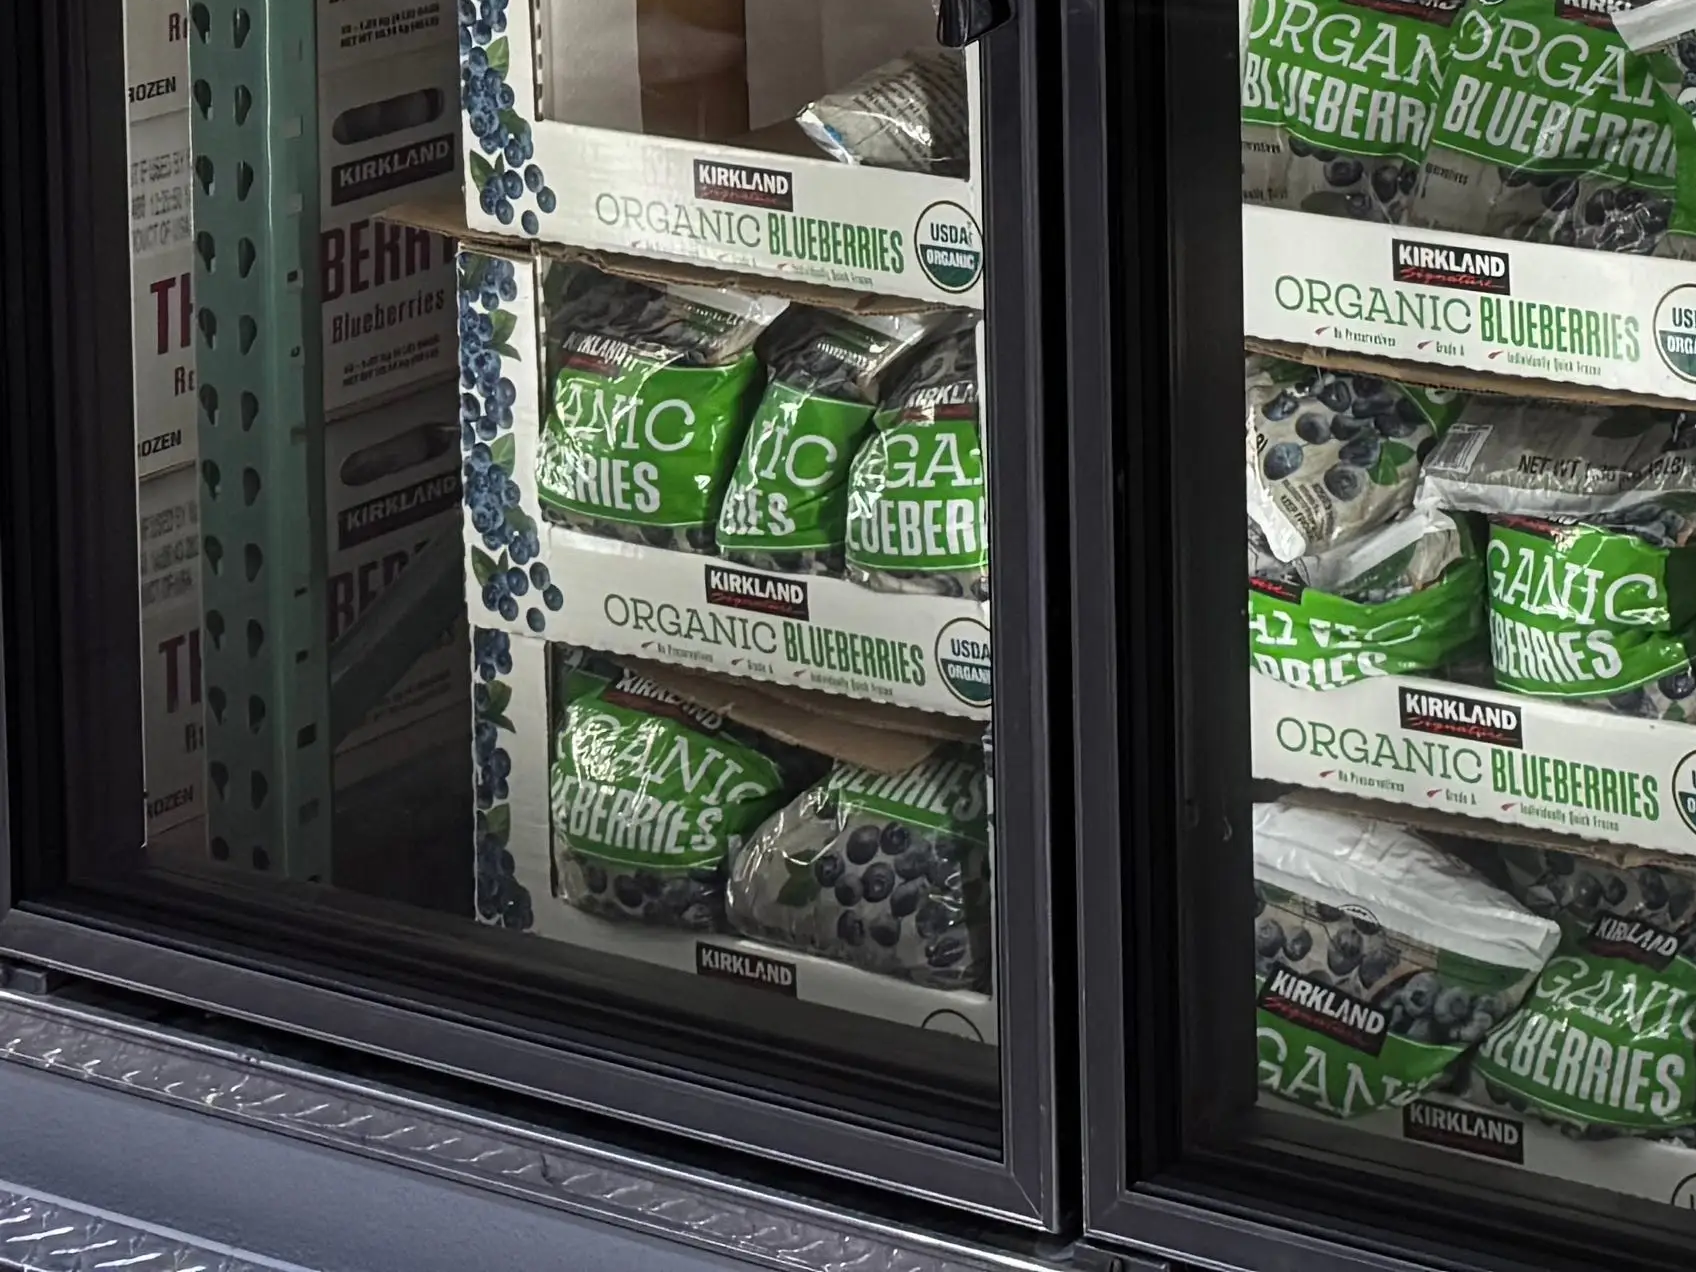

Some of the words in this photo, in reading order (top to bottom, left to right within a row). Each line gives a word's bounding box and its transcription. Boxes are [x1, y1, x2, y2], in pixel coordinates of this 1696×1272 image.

[339, 140, 450, 187] KIRKLAND
[699, 165, 789, 195] KIRKLAND
[595, 193, 762, 248] ORGANIC
[768, 213, 905, 274] BLUEBERRIES
[1400, 245, 1506, 277] KIRKLAND
[332, 287, 445, 345] Blueberries
[1275, 276, 1471, 334] ORGANIC
[1480, 297, 1641, 362] BLUEBERRIES
[710, 572, 804, 604] KIRKLAND
[603, 594, 777, 654] ORGANIC
[783, 623, 926, 687] BLUEBERRIES
[1405, 692, 1518, 729] KIRKLAND
[1276, 718, 1482, 784] ORGANIC
[1492, 749, 1660, 821] BLUEBERRIES
